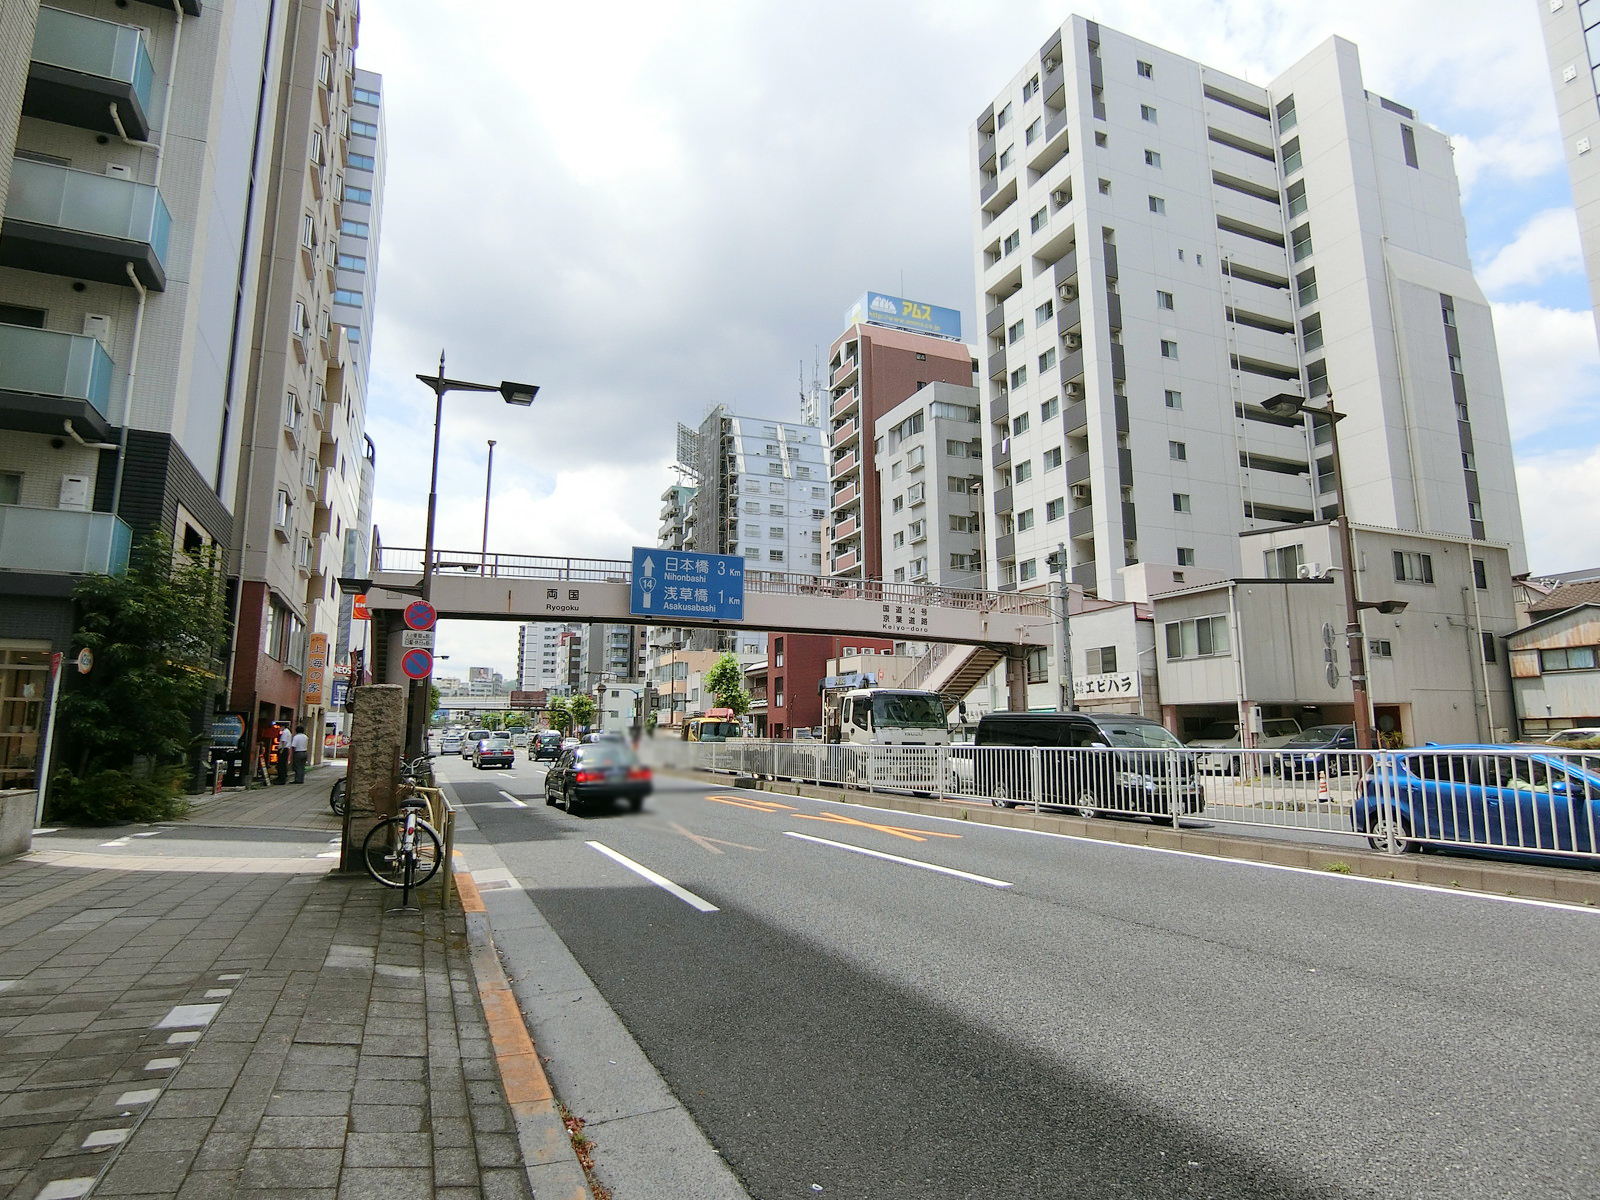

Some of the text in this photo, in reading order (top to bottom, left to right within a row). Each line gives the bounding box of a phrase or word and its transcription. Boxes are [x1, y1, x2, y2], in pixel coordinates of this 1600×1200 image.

[902, 302, 930, 320] アムス
[665, 557, 741, 577] 日本橋 3 Km
[664, 572, 706, 583] Nihonbashi
[642, 579, 653, 589] 14
[547, 589, 579, 600] 両国
[663, 586, 740, 605] 浅草橋 1 Km
[546, 603, 579, 612] Ryogoku
[663, 601, 716, 612] Asakusabashi
[882, 604, 928, 616] 国道14号
[882, 614, 928, 626] 京葉道路
[882, 624, 928, 632] Keiyo-doro
[1085, 676, 1132, 694] エビハラ
